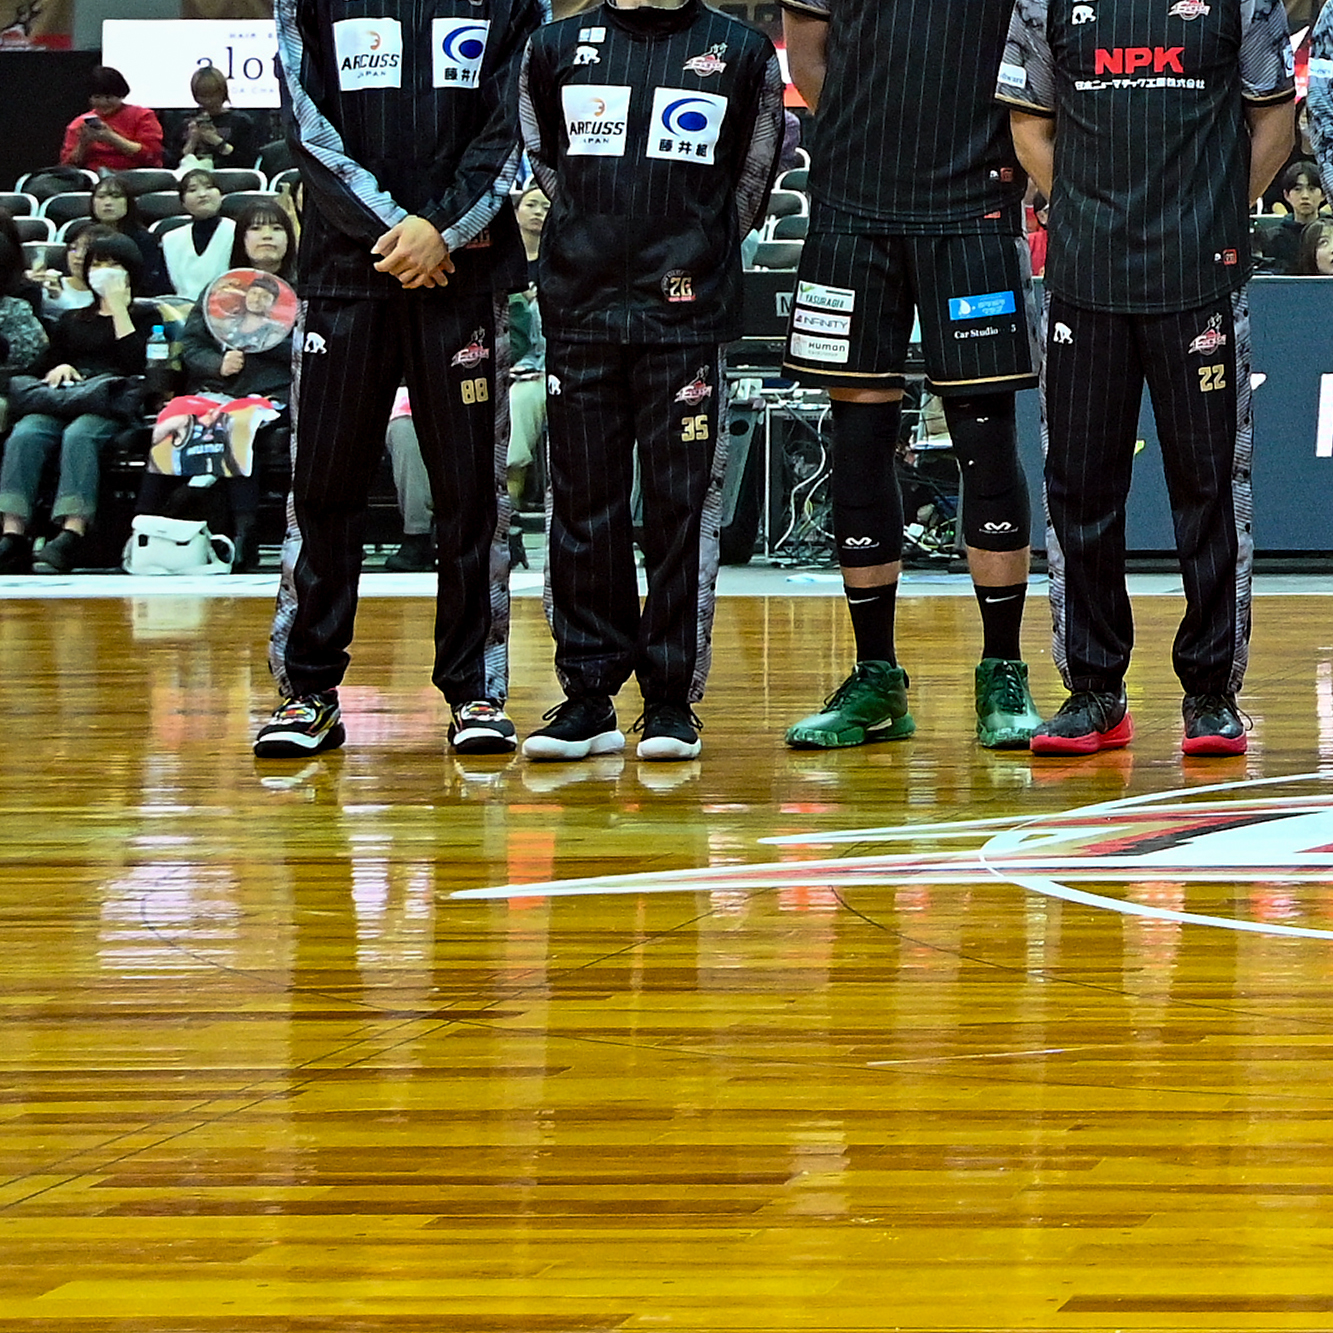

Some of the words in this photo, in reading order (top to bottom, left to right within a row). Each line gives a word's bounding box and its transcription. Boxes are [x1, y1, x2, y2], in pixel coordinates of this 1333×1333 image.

[341, 53, 400, 71] ARCUSS
[1095, 46, 1185, 75] NPK
[569, 121, 625, 136] ARCUSS
[461, 377, 489, 405] 88
[1198, 364, 1226, 392] 22
[681, 414, 709, 442] 35
